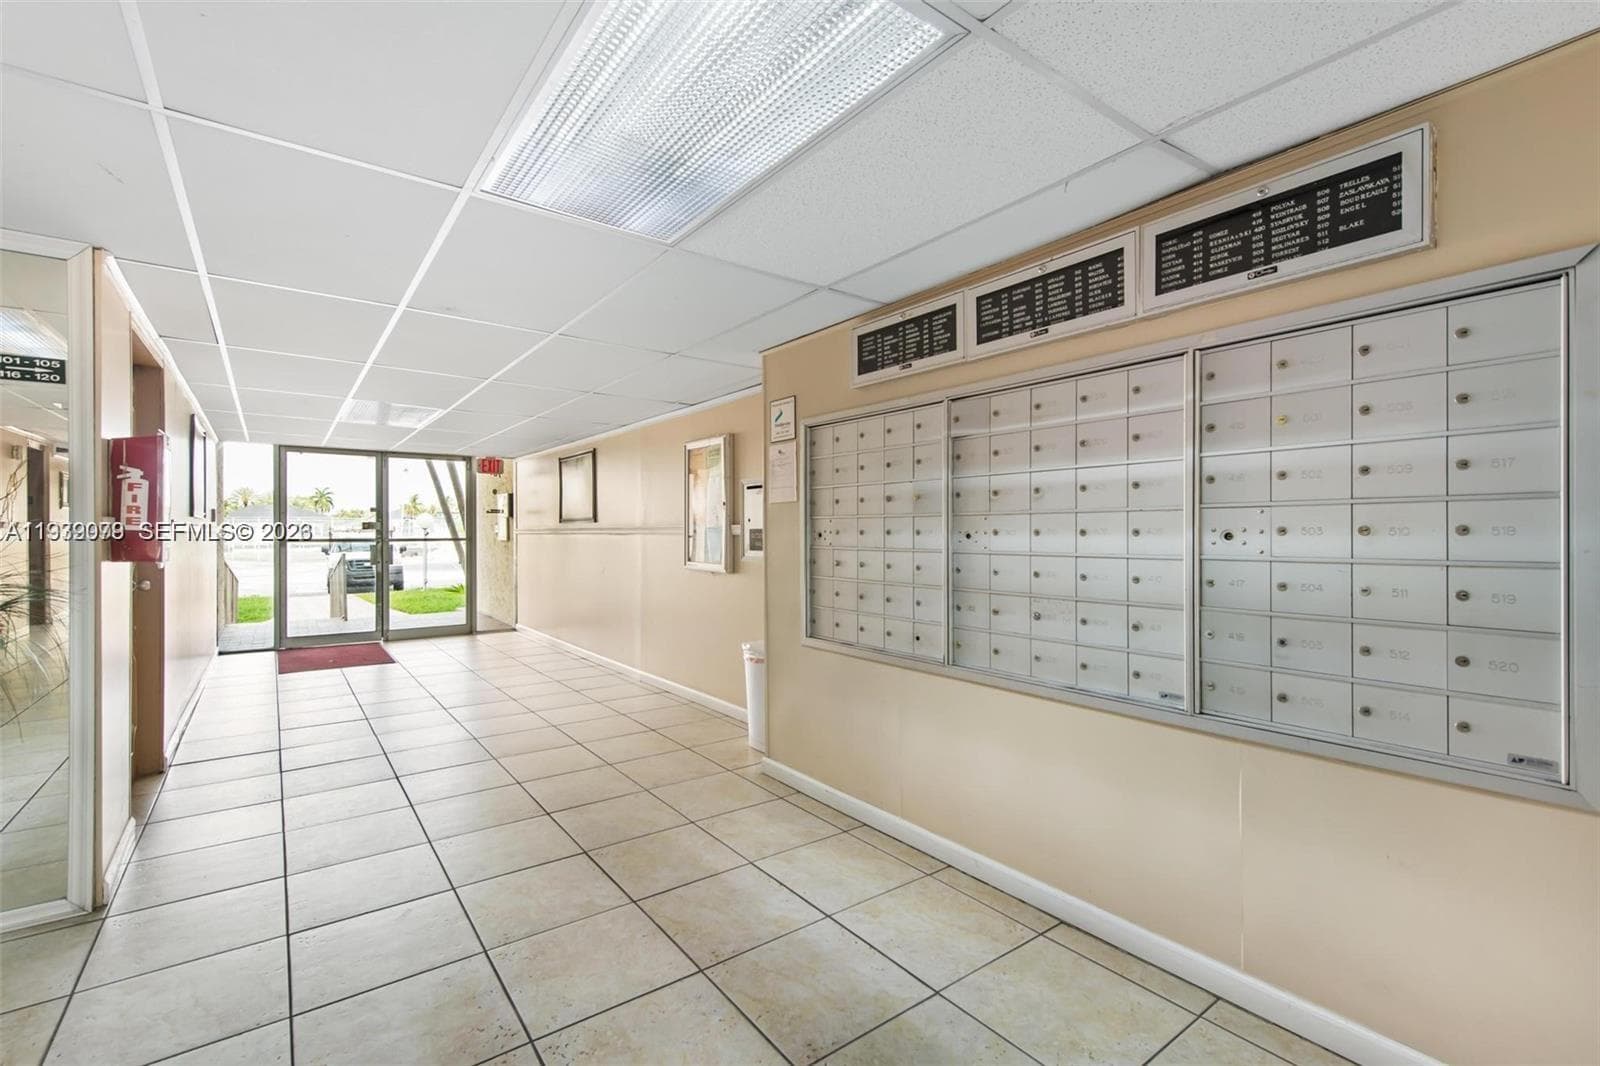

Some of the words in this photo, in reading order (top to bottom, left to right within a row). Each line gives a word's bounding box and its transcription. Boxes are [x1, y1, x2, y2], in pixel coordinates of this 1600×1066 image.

[1338, 176, 1370, 189] TRELLES
[1338, 177, 1390, 198] ZASLAVSKAYA
[1340, 186, 1389, 206] BOUDREAULT
[1270, 200, 1296, 212] POLYAK
[1340, 202, 1367, 214] ENGEL
[1338, 220, 1366, 232] BLAKE
[33, 359, 60, 368] 105
[0, 370, 20, 378] 116
[34, 373, 60, 382] 120
[482, 458, 500, 474] EXIT
[126, 482, 142, 526] FIRE
[1300, 526, 1324, 537] 503
[1490, 525, 1517, 538] 518
[1300, 581, 1324, 593] 504
[1391, 588, 1409, 599] 511
[1389, 649, 1411, 660] 512
[1488, 660, 1520, 674] 520
